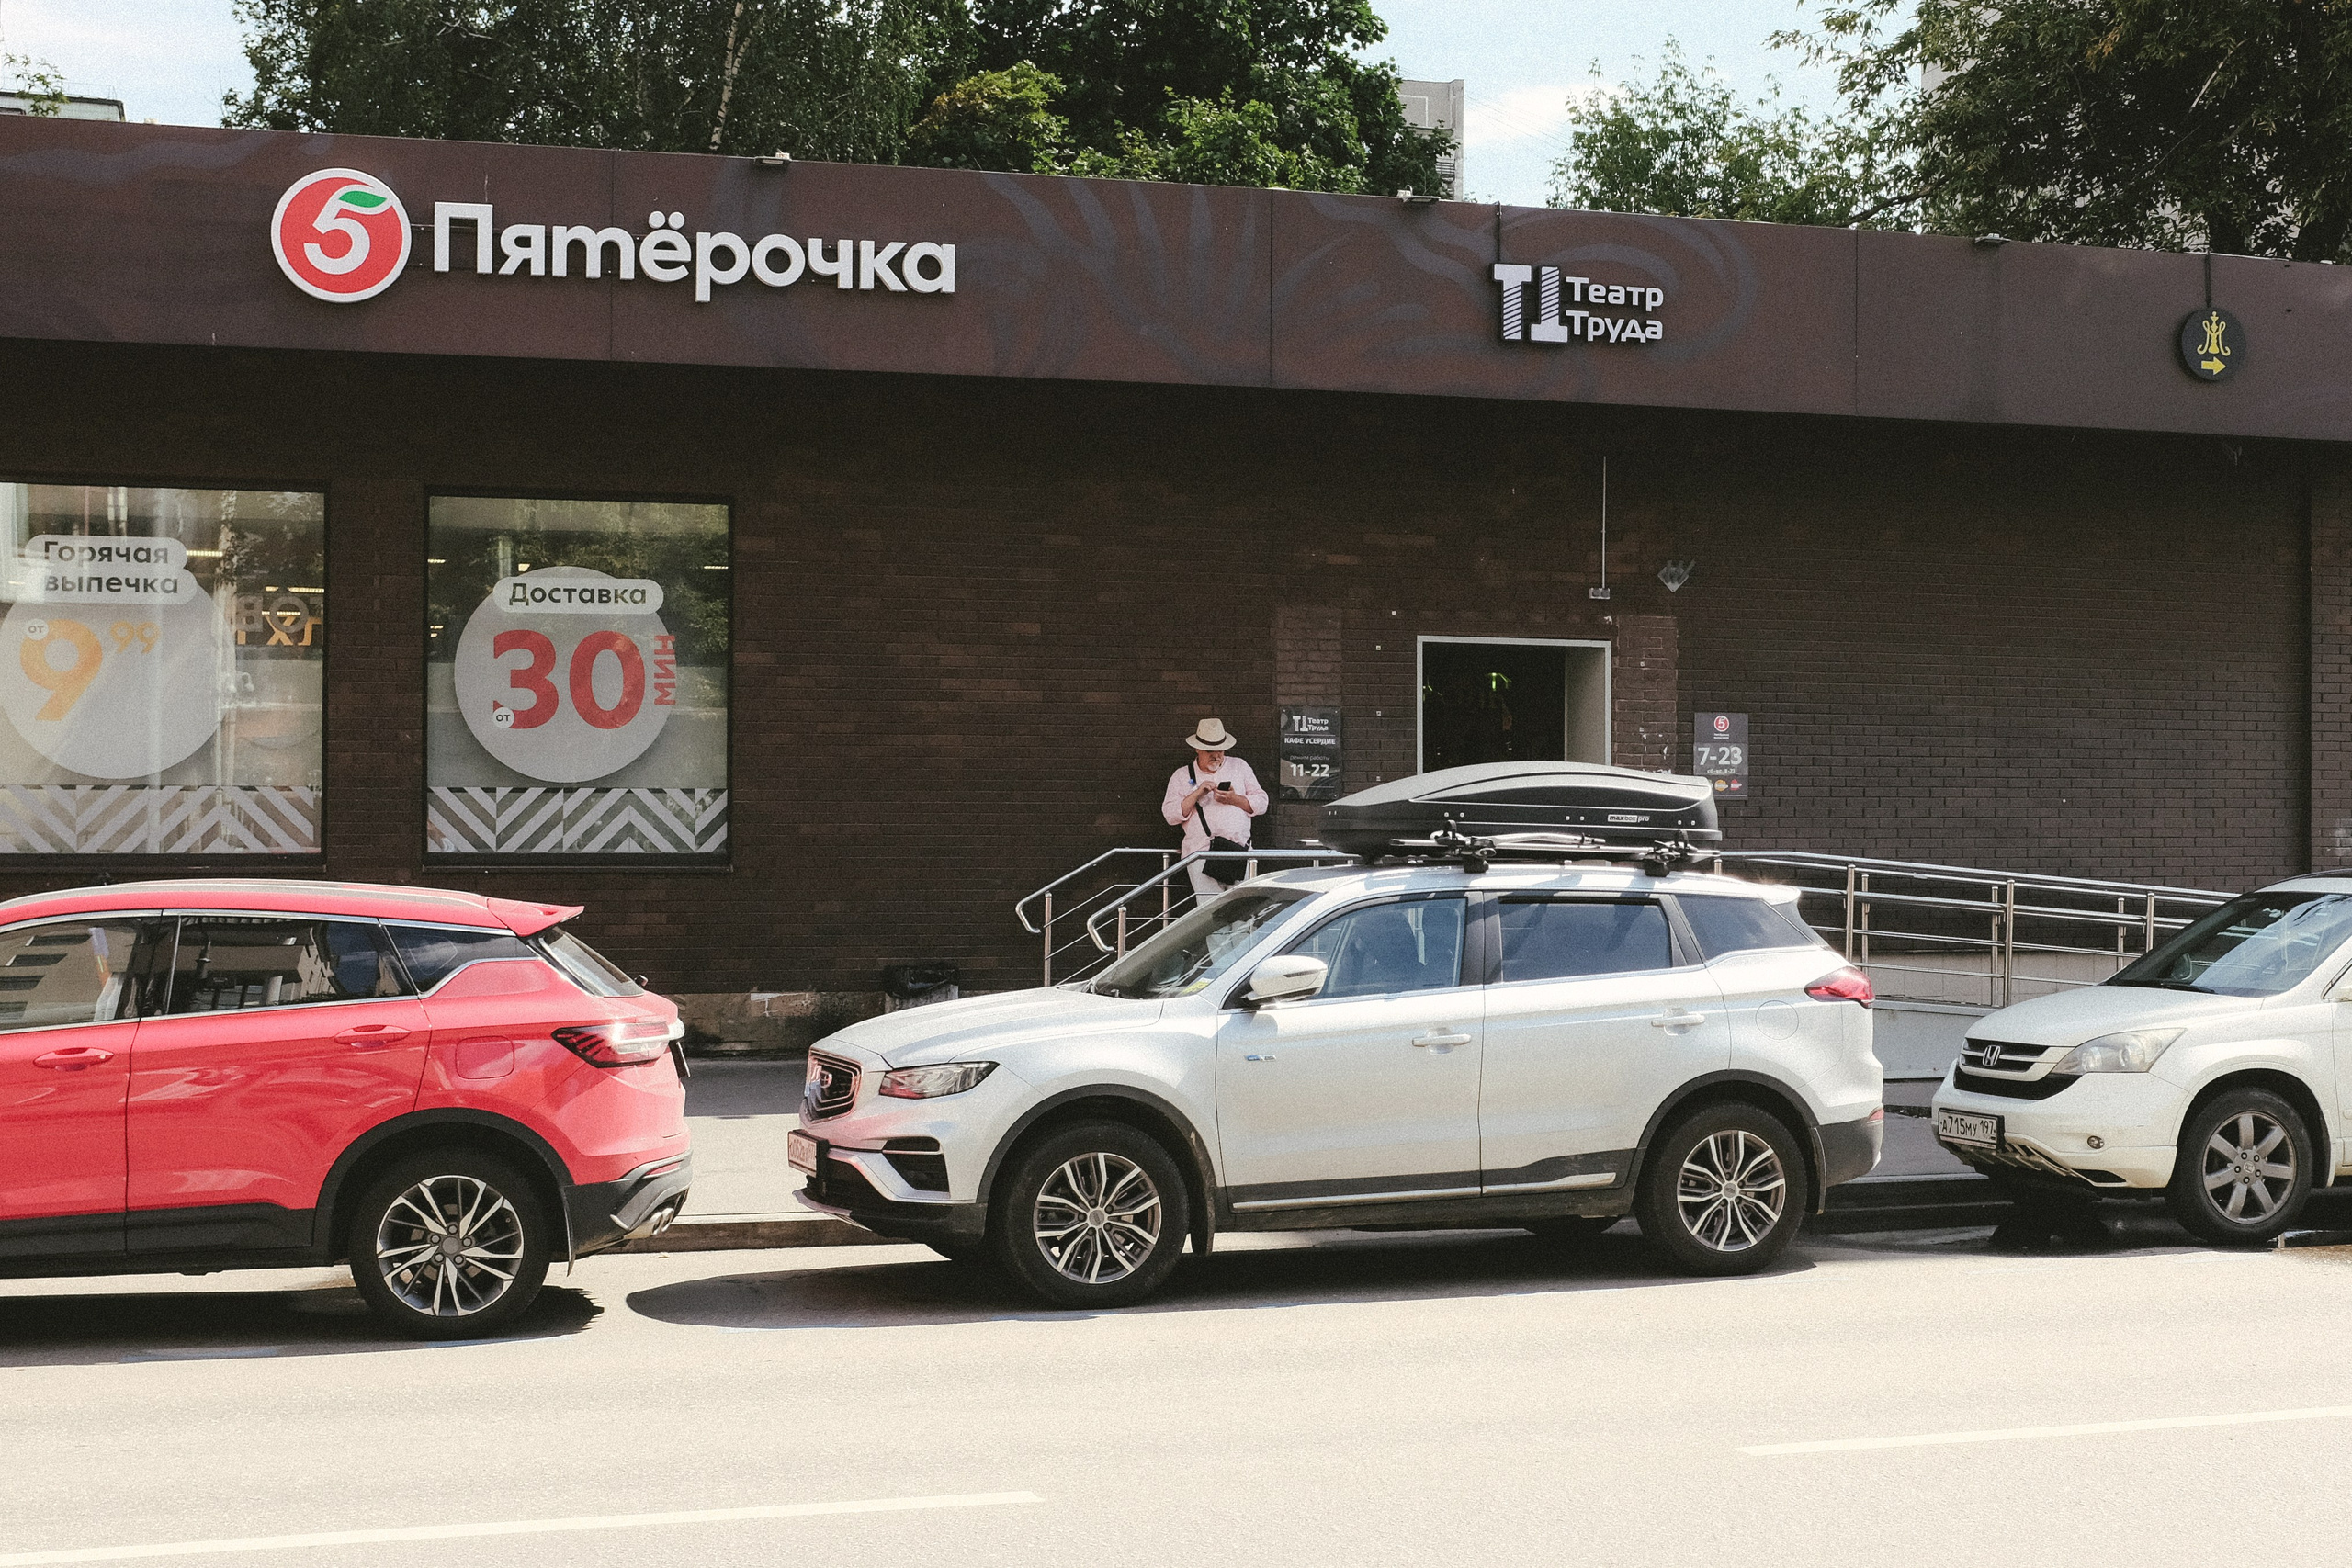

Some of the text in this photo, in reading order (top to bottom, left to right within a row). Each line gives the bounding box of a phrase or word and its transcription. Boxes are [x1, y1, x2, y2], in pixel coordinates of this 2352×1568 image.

[434, 201, 956, 302] Пятёрочка
[1566, 276, 1664, 311] Театр
[1566, 310, 1664, 343] Труда
[44, 541, 169, 567] Горячая
[45, 575, 179, 594] выпечка
[508, 582, 647, 606] Доставка
[19, 618, 104, 722] 9
[109, 620, 161, 654] 99
[492, 629, 646, 730] от 30
[1698, 746, 1742, 766] 7-23
[1290, 763, 1329, 777] 11-22
[1980, 1120, 1994, 1134] 197
